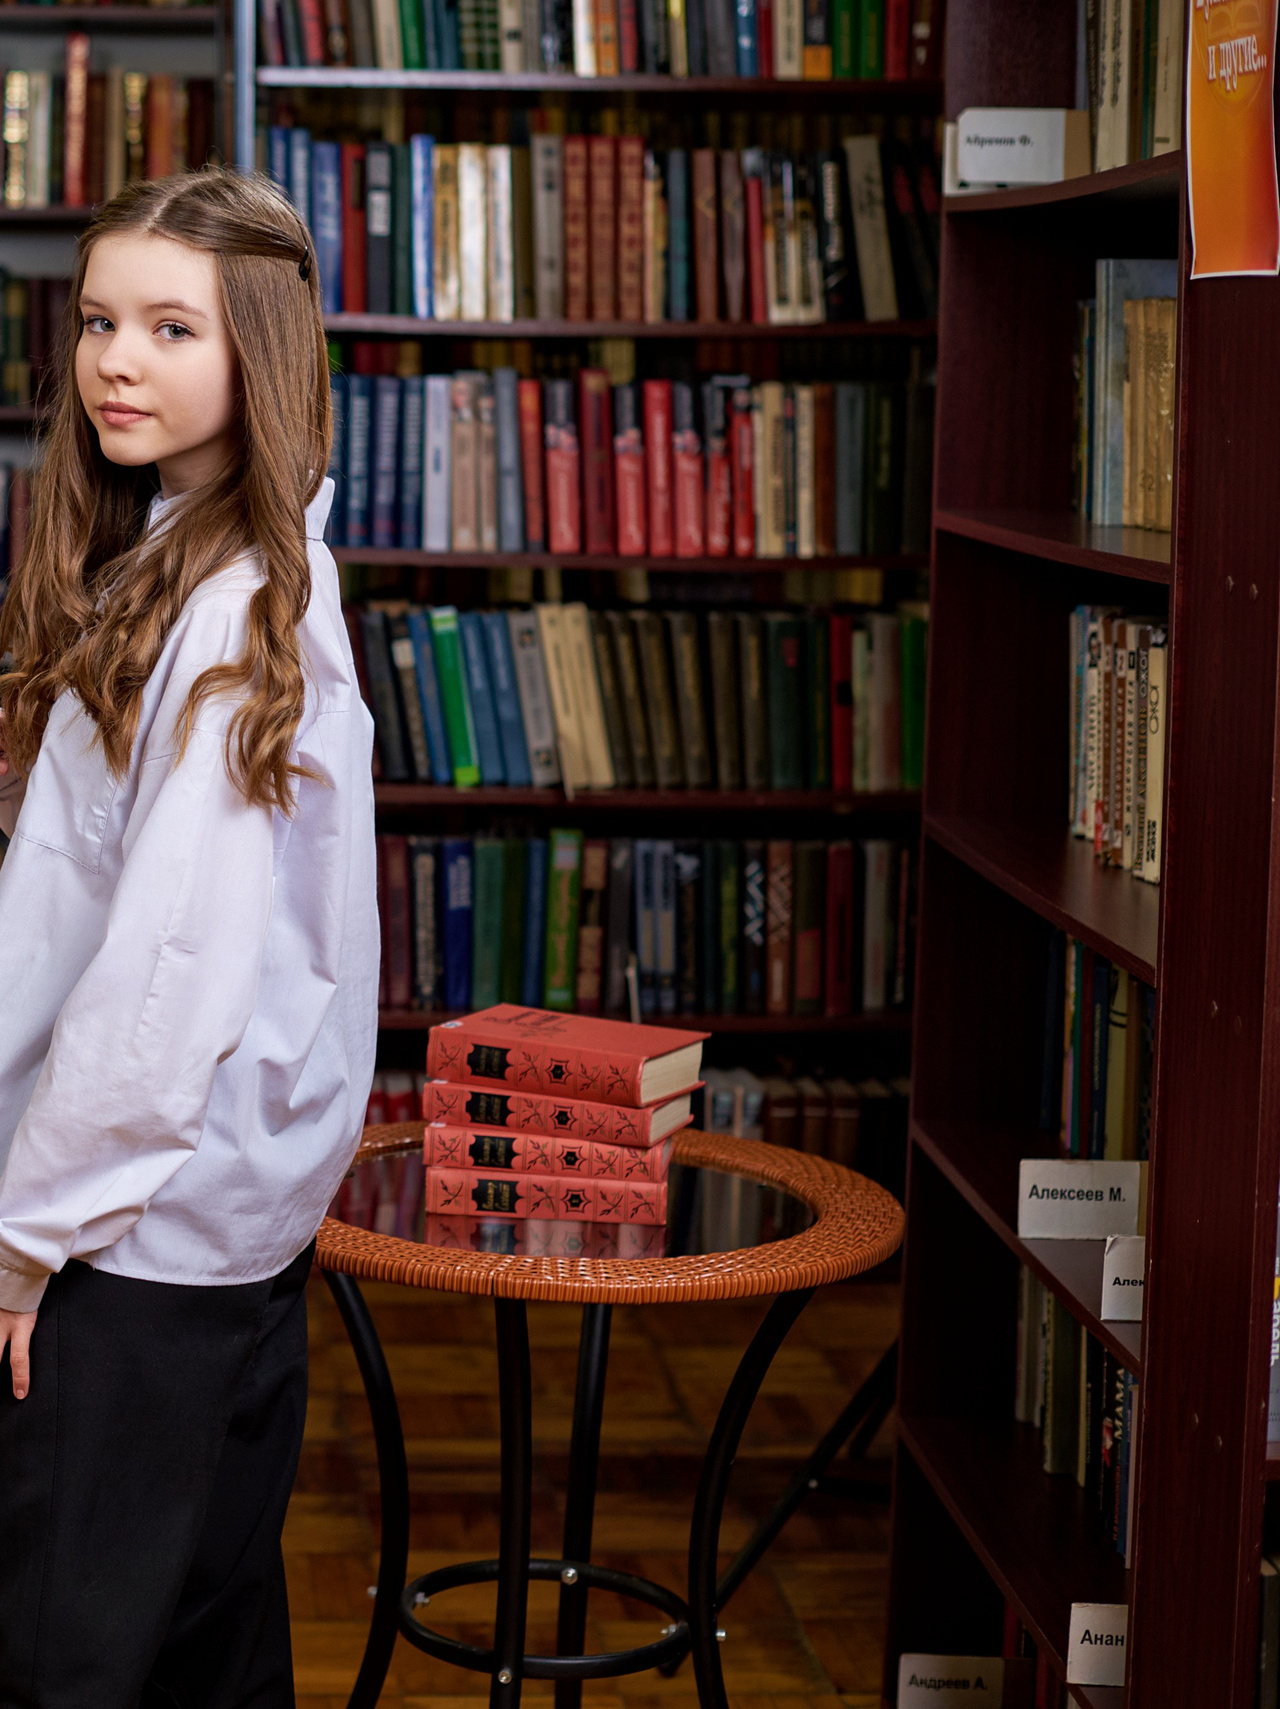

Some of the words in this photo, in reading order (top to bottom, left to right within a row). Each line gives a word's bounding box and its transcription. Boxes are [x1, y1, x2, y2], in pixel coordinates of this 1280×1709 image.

[1208, 45, 1216, 80] и
[1219, 34, 1267, 91] другие...
[1028, 1184, 1104, 1201] Алексеев
[1109, 1187, 1126, 1202] М.
[1112, 1276, 1145, 1287] Алек
[1080, 1629, 1125, 1646] Анан
[908, 1674, 970, 1691] Андреев
[974, 1676, 988, 1690] А.
